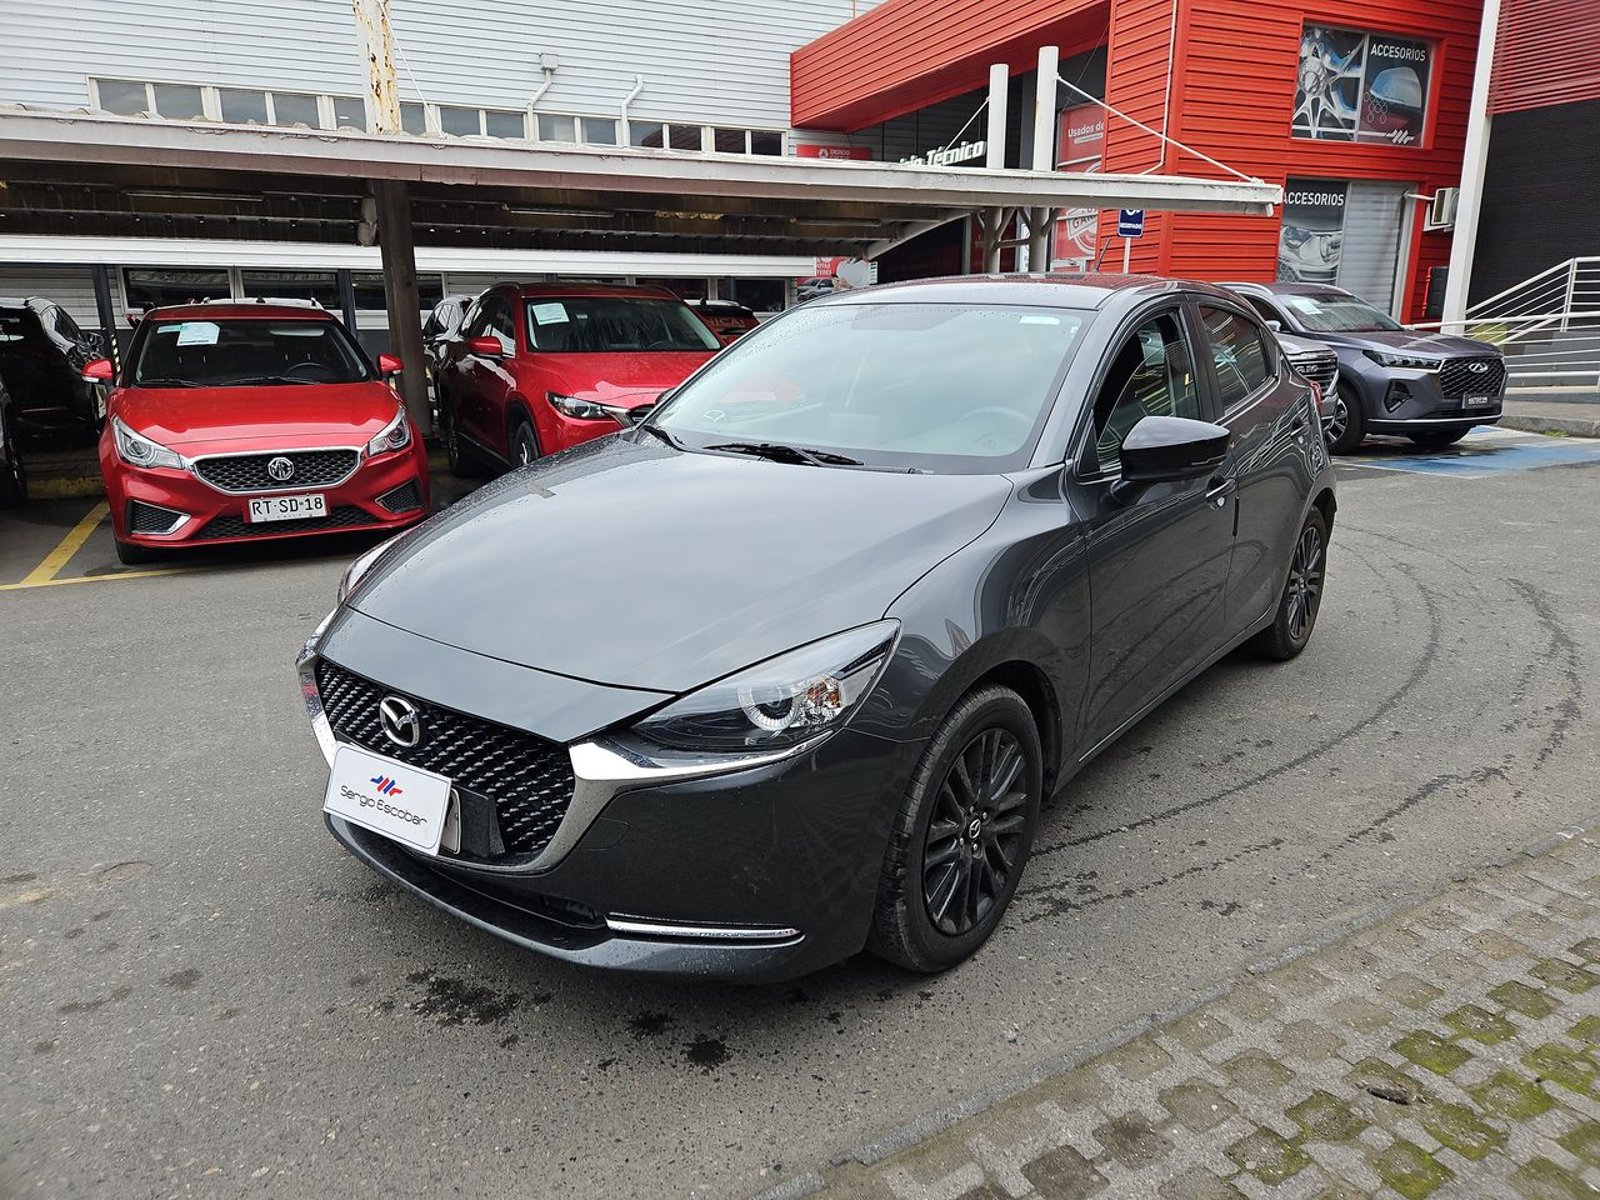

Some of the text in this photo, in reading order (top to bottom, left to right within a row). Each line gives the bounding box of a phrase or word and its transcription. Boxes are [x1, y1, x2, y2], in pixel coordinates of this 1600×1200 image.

[1370, 43, 1426, 62] ACCESORIOS
[1068, 124, 1095, 138] Usados
[926, 140, 987, 166] Técnico
[1283, 191, 1345, 206] ACCESORIOS
[376, 799, 428, 826] Escobar
